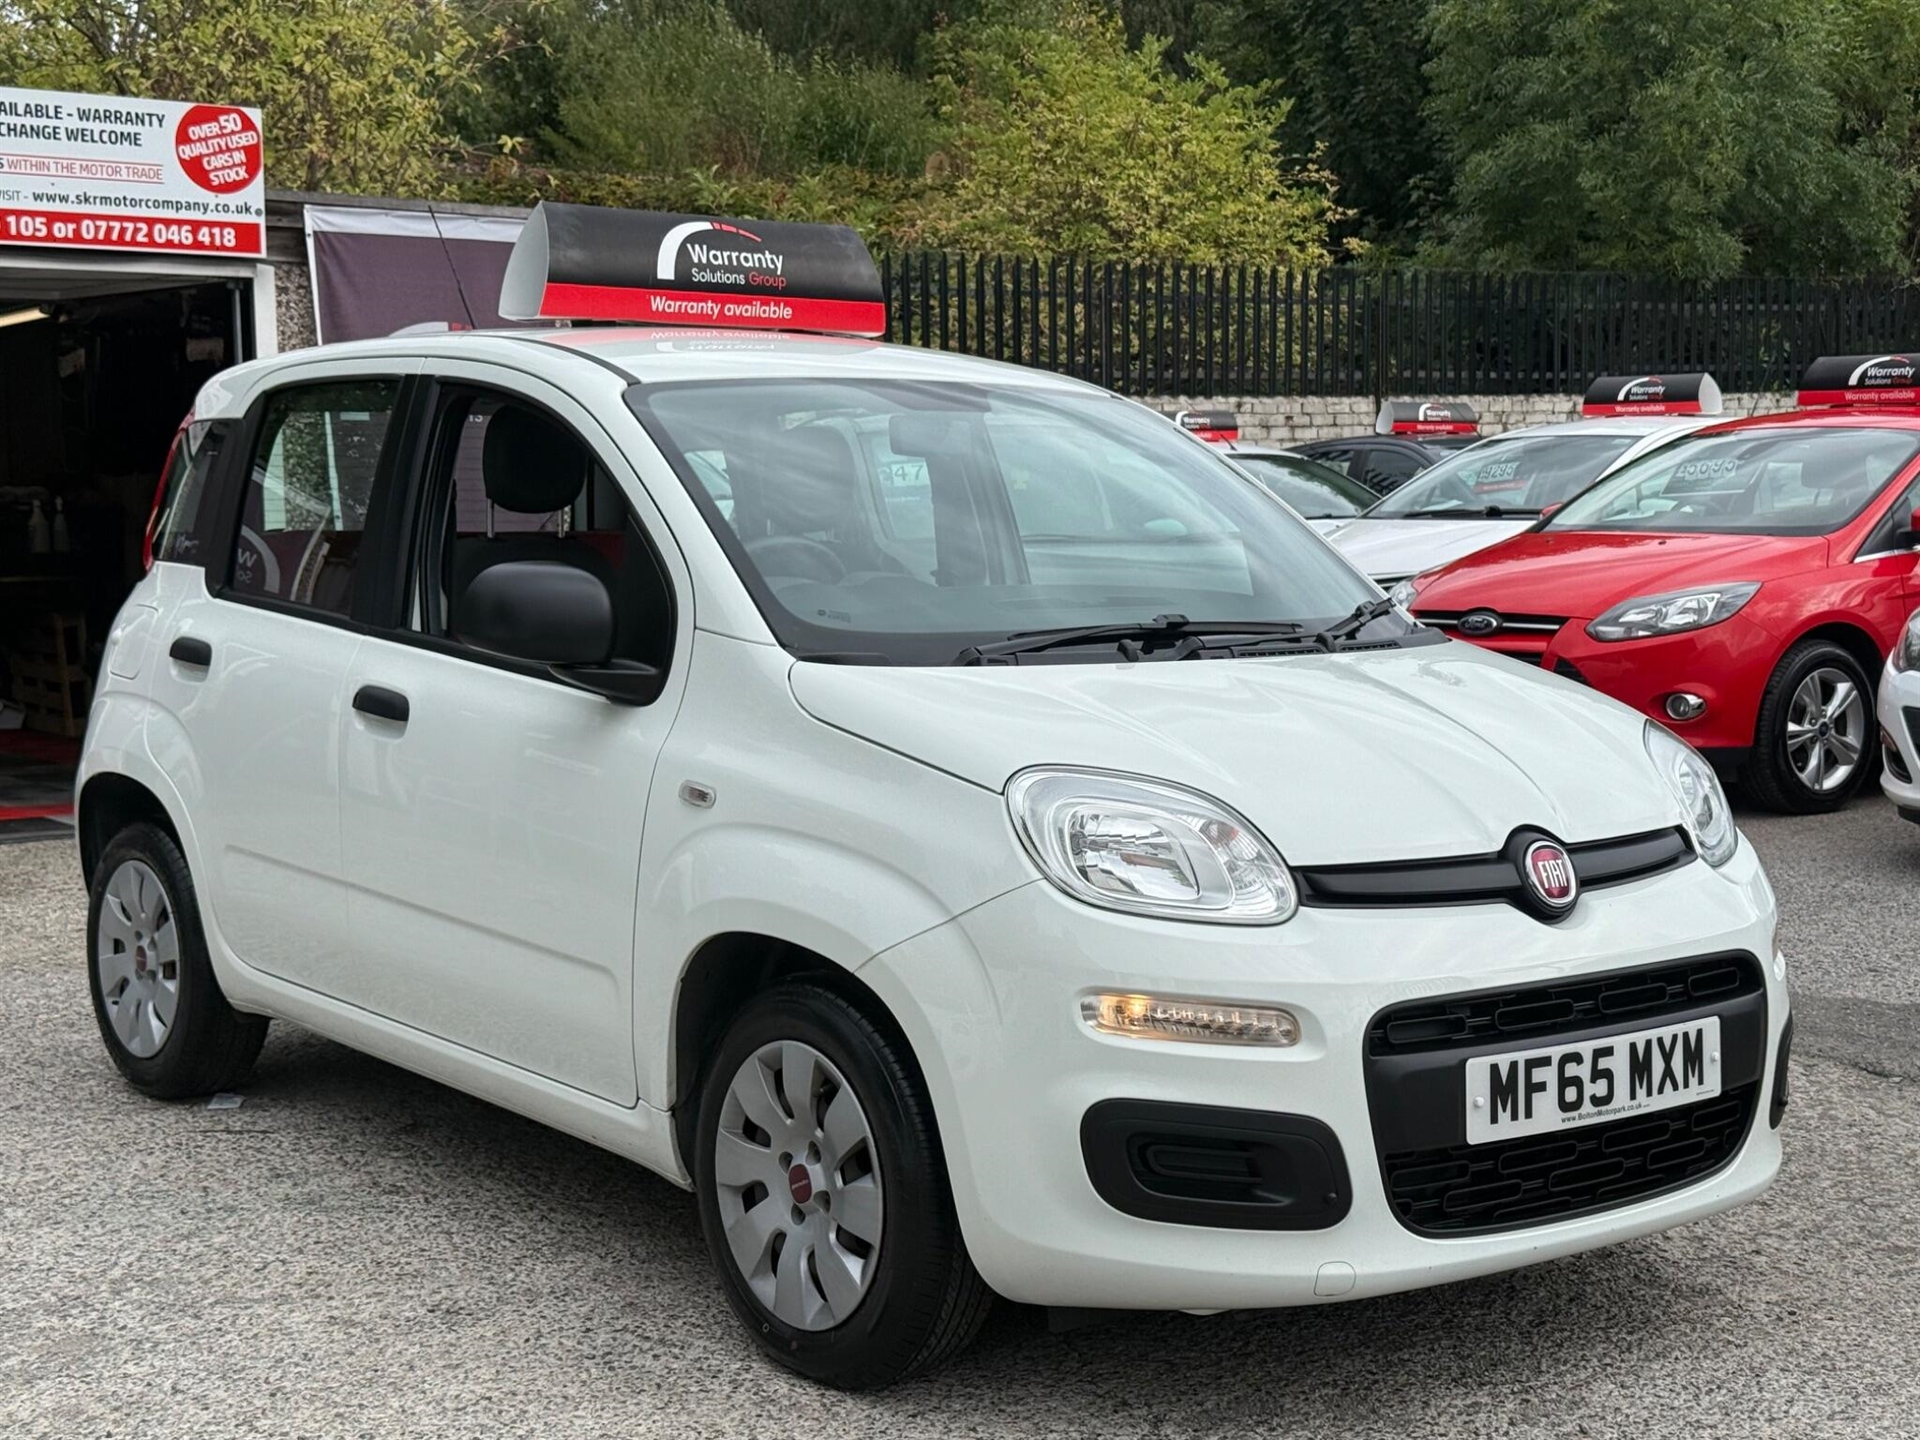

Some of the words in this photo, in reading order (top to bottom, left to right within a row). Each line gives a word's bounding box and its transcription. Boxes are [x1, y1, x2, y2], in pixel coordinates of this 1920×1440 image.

[77, 107, 166, 128] WARRANTY
[188, 122, 220, 140] OVER
[218, 113, 242, 133] 50
[0, 121, 61, 141] CHANGE
[65, 127, 142, 147] WELCOME
[179, 137, 227, 161] QUALITY
[226, 131, 258, 149] USED
[7, 157, 50, 173] WITHIN
[53, 161, 76, 175] THE
[80, 163, 122, 178] MOTOR
[125, 166, 163, 181] TRADE
[202, 152, 233, 170] CARS
[232, 149, 246, 164] IN
[209, 166, 249, 186] STOCK
[33, 191, 252, 215] www.skrmotorcompany.co.uk
[6, 215, 48, 237] 105
[53, 222, 77, 239] or
[81, 219, 149, 242] 07772
[153, 223, 193, 246] 046
[198, 226, 236, 248] 418
[687, 243, 783, 275] Warranty
[691, 267, 746, 285] Solutions
[749, 272, 787, 291] Group
[650, 295, 721, 320] Warranty
[724, 301, 793, 319] available
[1867, 366, 1915, 378] Warranty
[1631, 385, 1665, 396] Warranty
[1844, 391, 1879, 402] Warranty
[1880, 390, 1915, 400] available
[1537, 858, 1568, 890] FIAT
[1489, 1045, 1615, 1125] MF65
[1629, 1027, 1704, 1101] MXM
